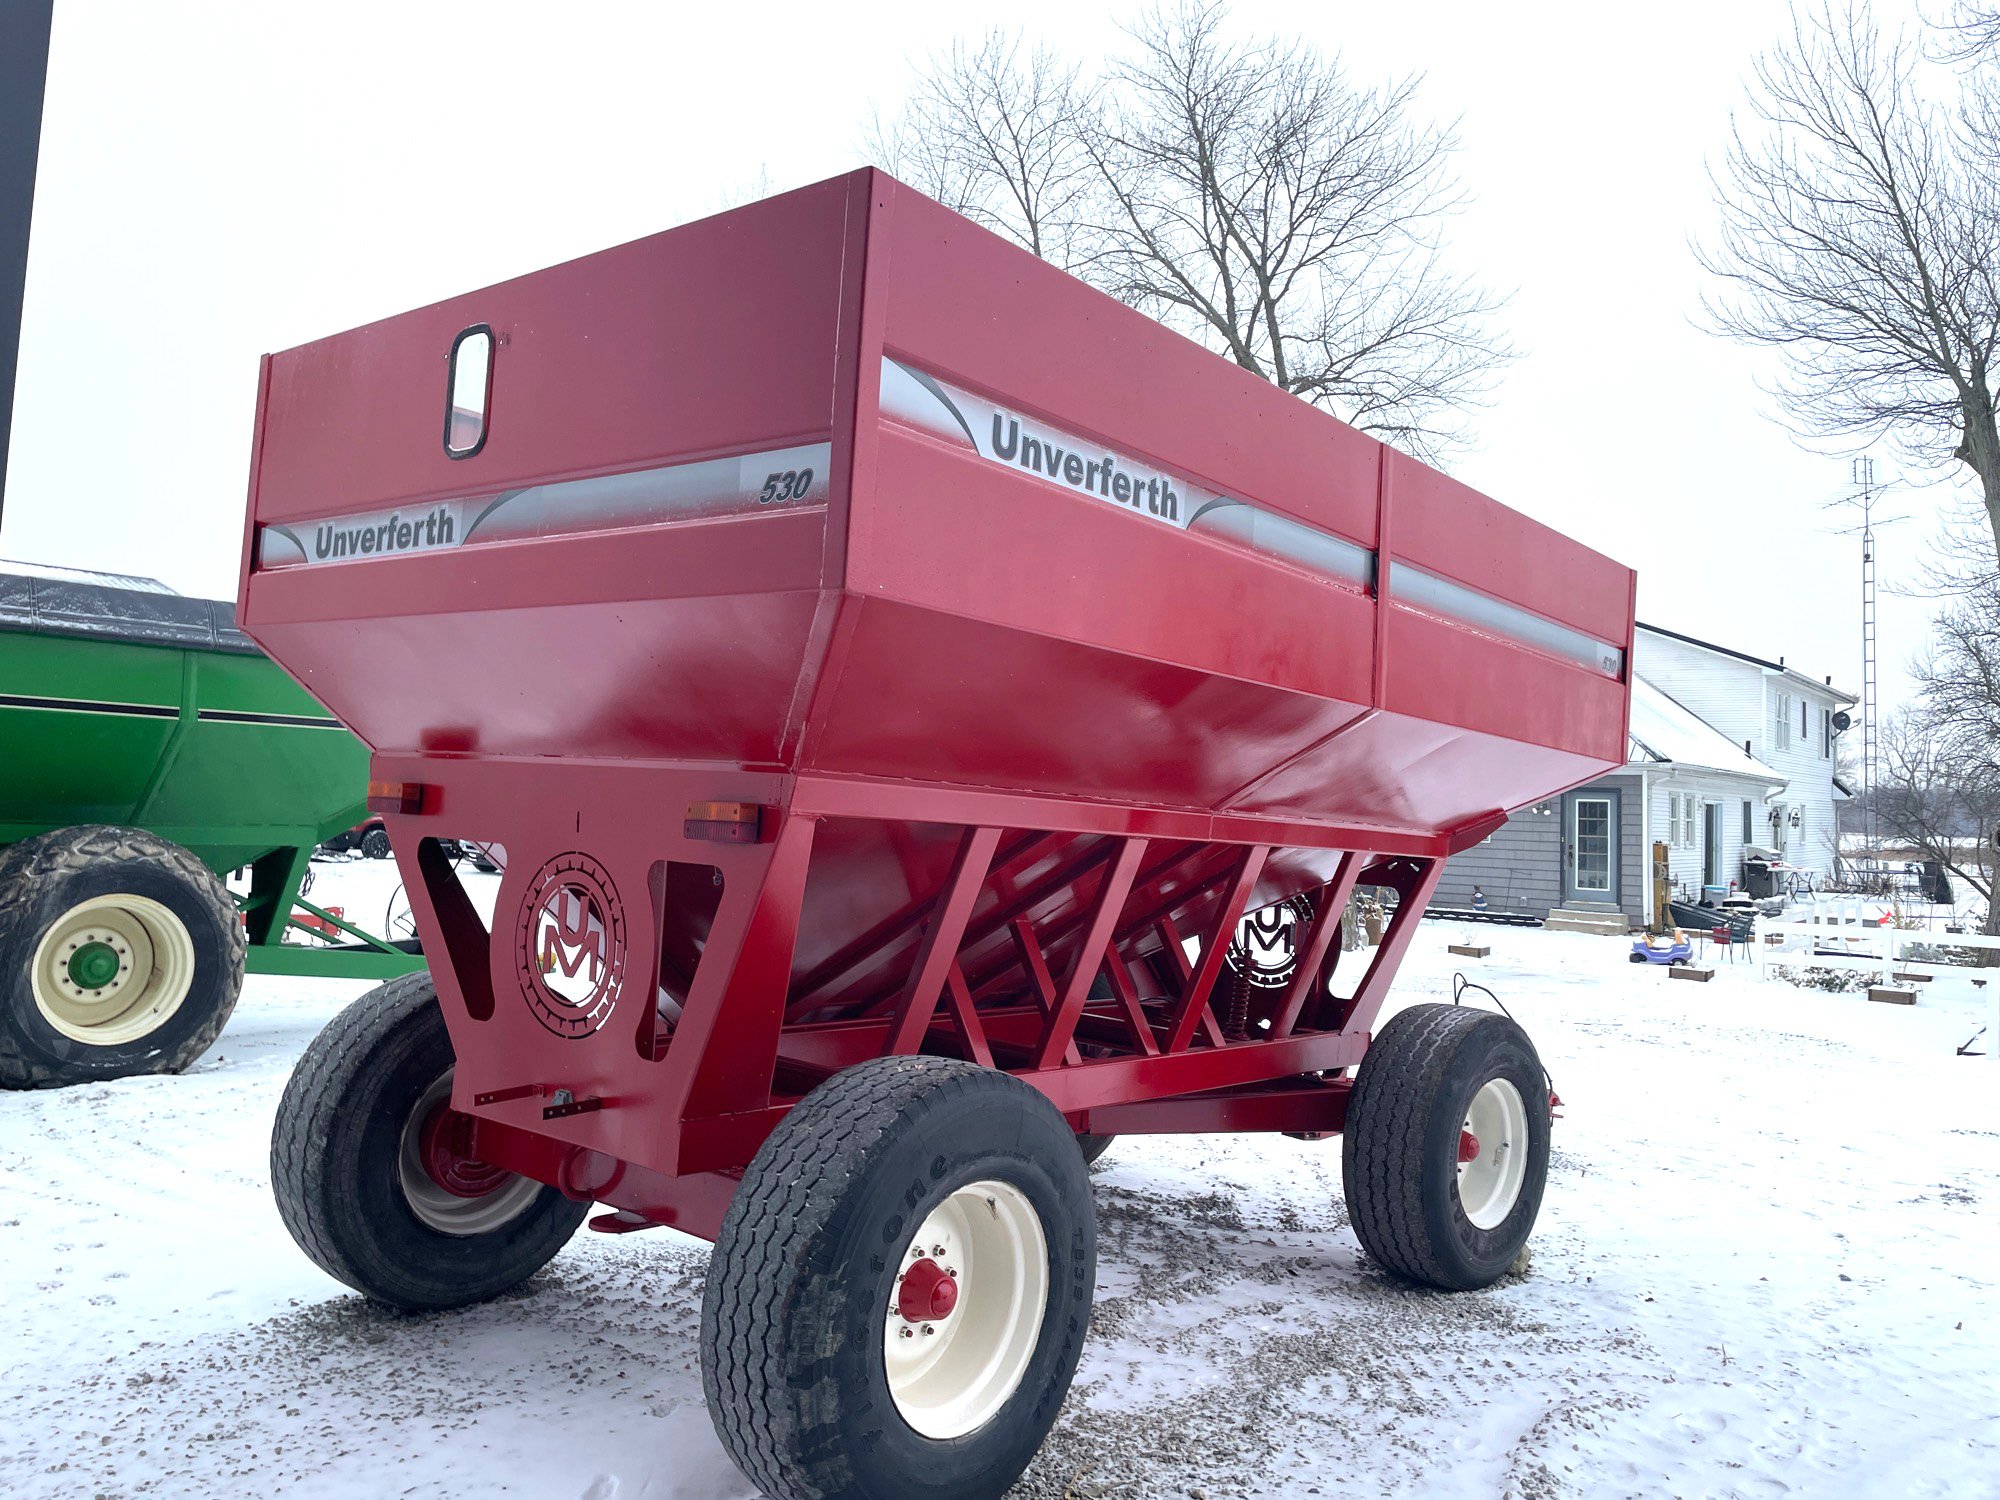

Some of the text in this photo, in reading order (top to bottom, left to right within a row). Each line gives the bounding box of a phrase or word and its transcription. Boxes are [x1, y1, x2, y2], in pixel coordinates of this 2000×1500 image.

[760, 467, 814, 504] 530
[990, 412, 1179, 523] Unverferth
[315, 508, 455, 560] Unverferth
[1602, 656, 1617, 673] 530
